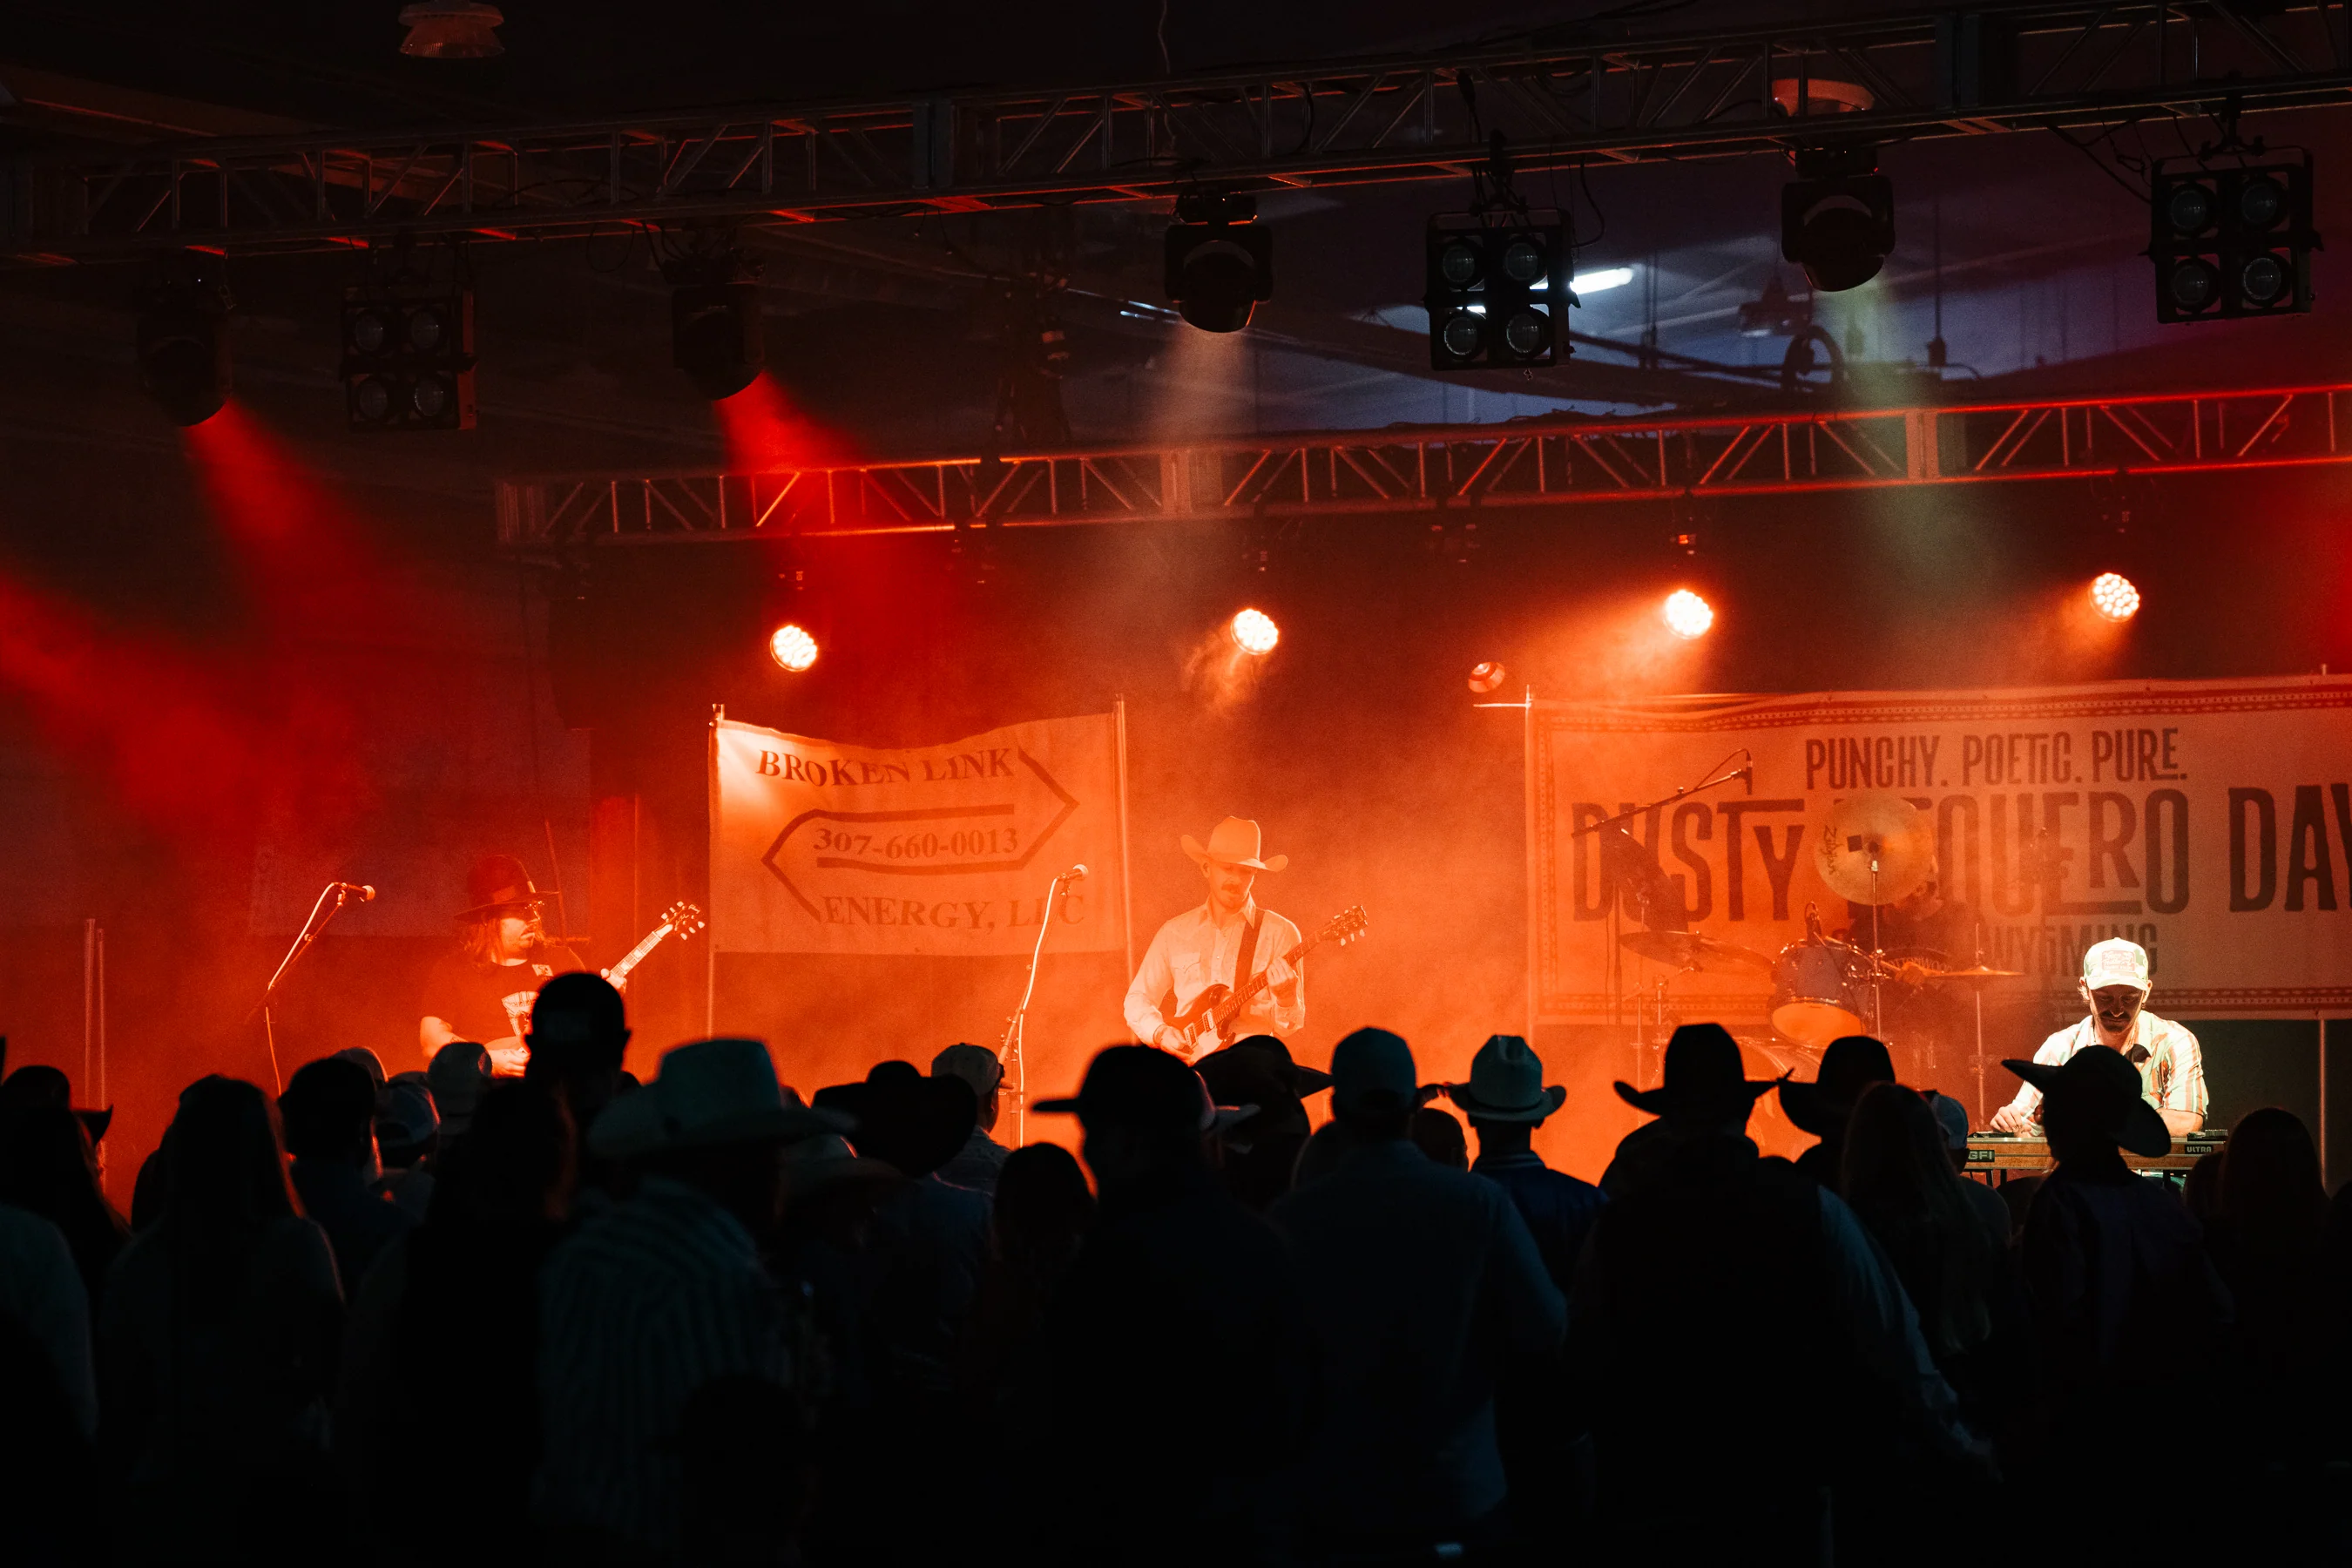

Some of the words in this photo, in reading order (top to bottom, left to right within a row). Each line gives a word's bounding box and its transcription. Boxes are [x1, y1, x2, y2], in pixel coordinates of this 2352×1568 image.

[756, 749, 910, 787] BROKEN
[923, 747, 1016, 781] LINK
[1806, 734, 1949, 790] PUNCHY.
[2092, 727, 2188, 782] PURE.
[813, 828, 1017, 860] 307-660-0013
[1571, 799, 1805, 922] DUSTY
[824, 896, 996, 935] ENERGY,
[1007, 894, 1085, 928] LLC
[1968, 1151, 1993, 1160] GFI
